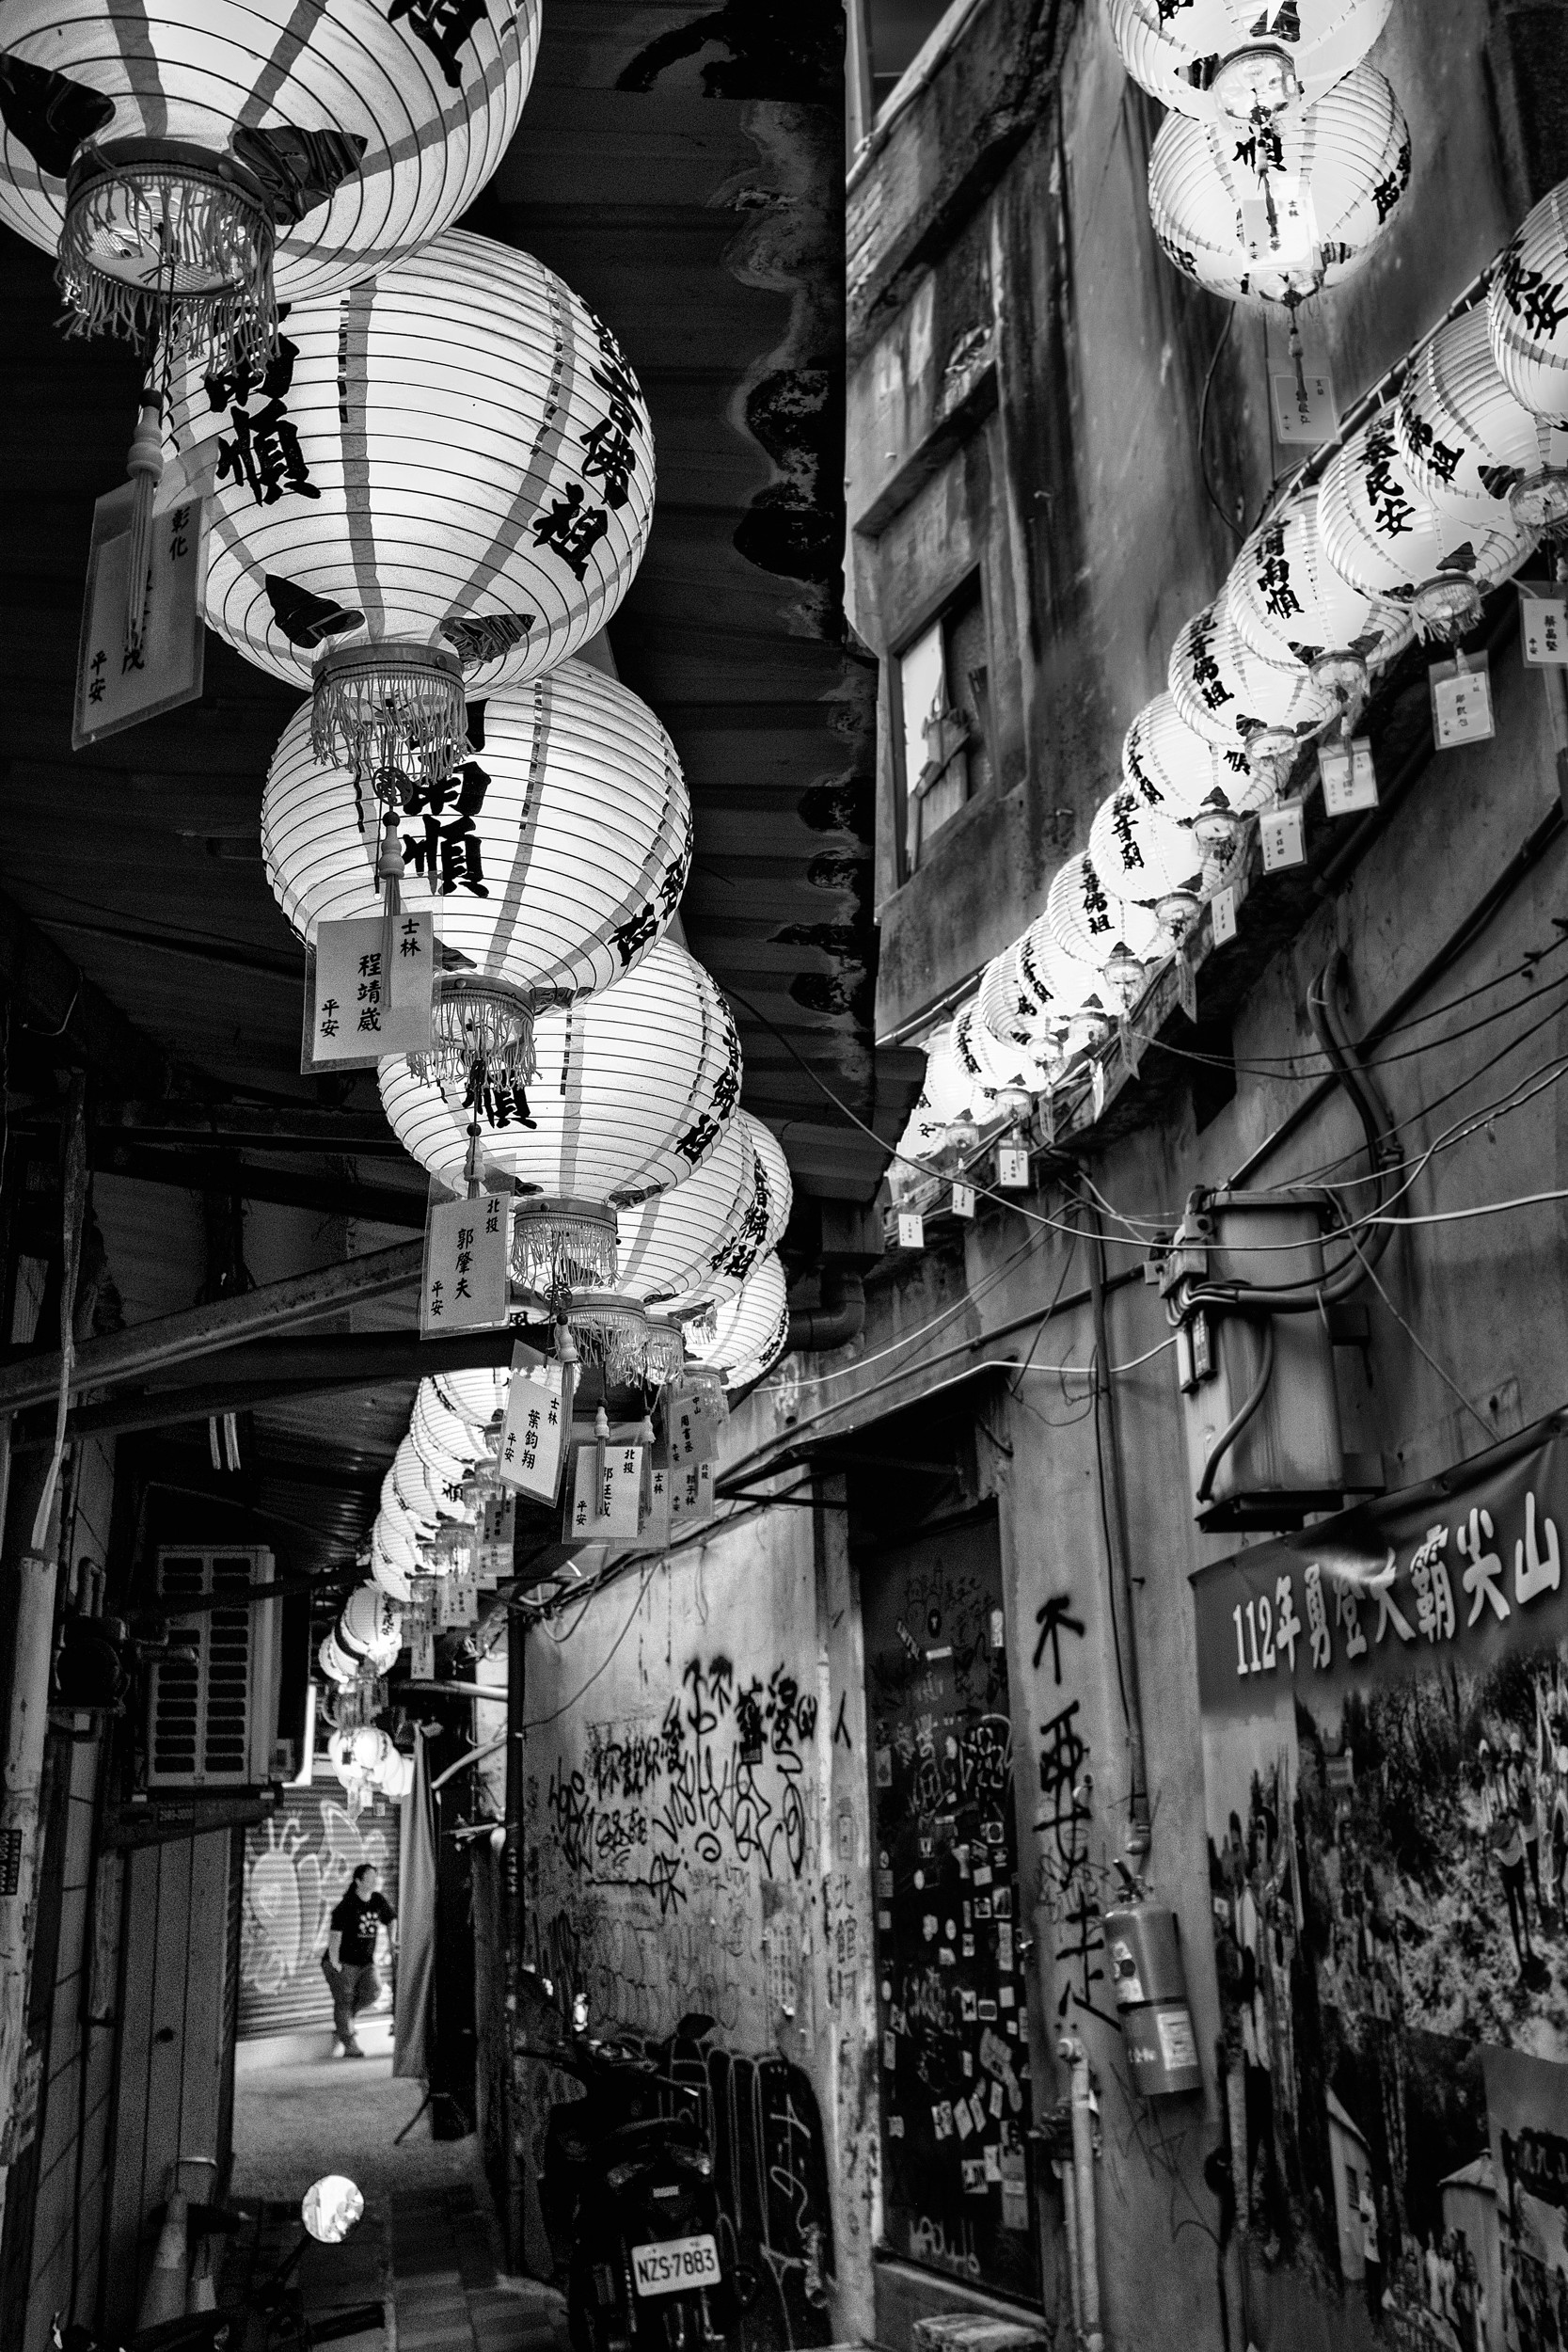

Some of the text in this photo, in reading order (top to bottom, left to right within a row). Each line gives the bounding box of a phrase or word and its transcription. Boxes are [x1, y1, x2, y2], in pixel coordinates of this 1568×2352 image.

[88, 649, 108, 706] 平安
[400, 918, 421, 958] 士林
[320, 998, 341, 1039] 平安
[485, 1198, 500, 1234] 北投
[454, 1227, 474, 1300] 郭肇夫
[431, 1279, 444, 1316] 平安
[547, 1397, 561, 1426] 士林
[503, 1432, 517, 1463] 平安
[623, 1449, 636, 1474] 北投
[653, 1472, 665, 1495] 士林
[576, 1500, 588, 1526] 平安
